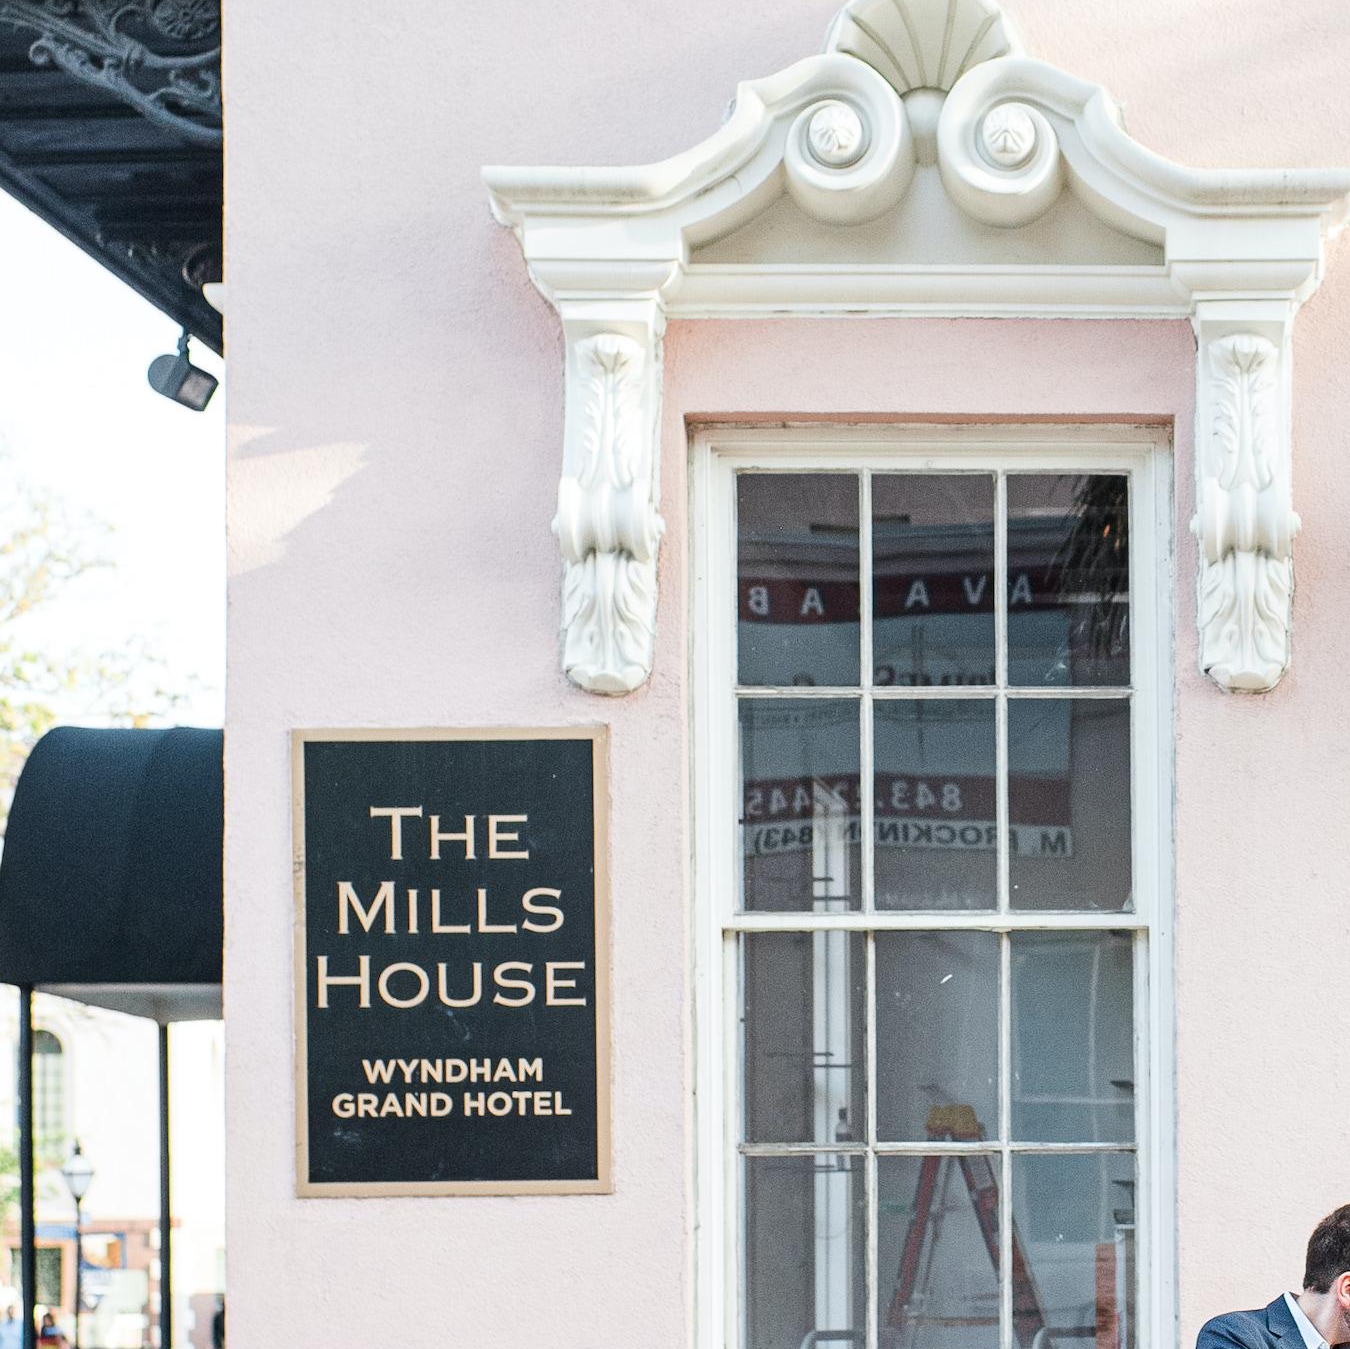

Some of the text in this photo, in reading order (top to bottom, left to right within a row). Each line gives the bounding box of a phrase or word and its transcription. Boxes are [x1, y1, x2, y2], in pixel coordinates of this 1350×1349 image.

[370, 806, 530, 860] THE
[337, 881, 565, 935] MILLS
[317, 954, 587, 1009] HOUSE
[361, 1057, 544, 1085] WYNDHAM
[331, 1090, 573, 1118] GRAND HOTEL
